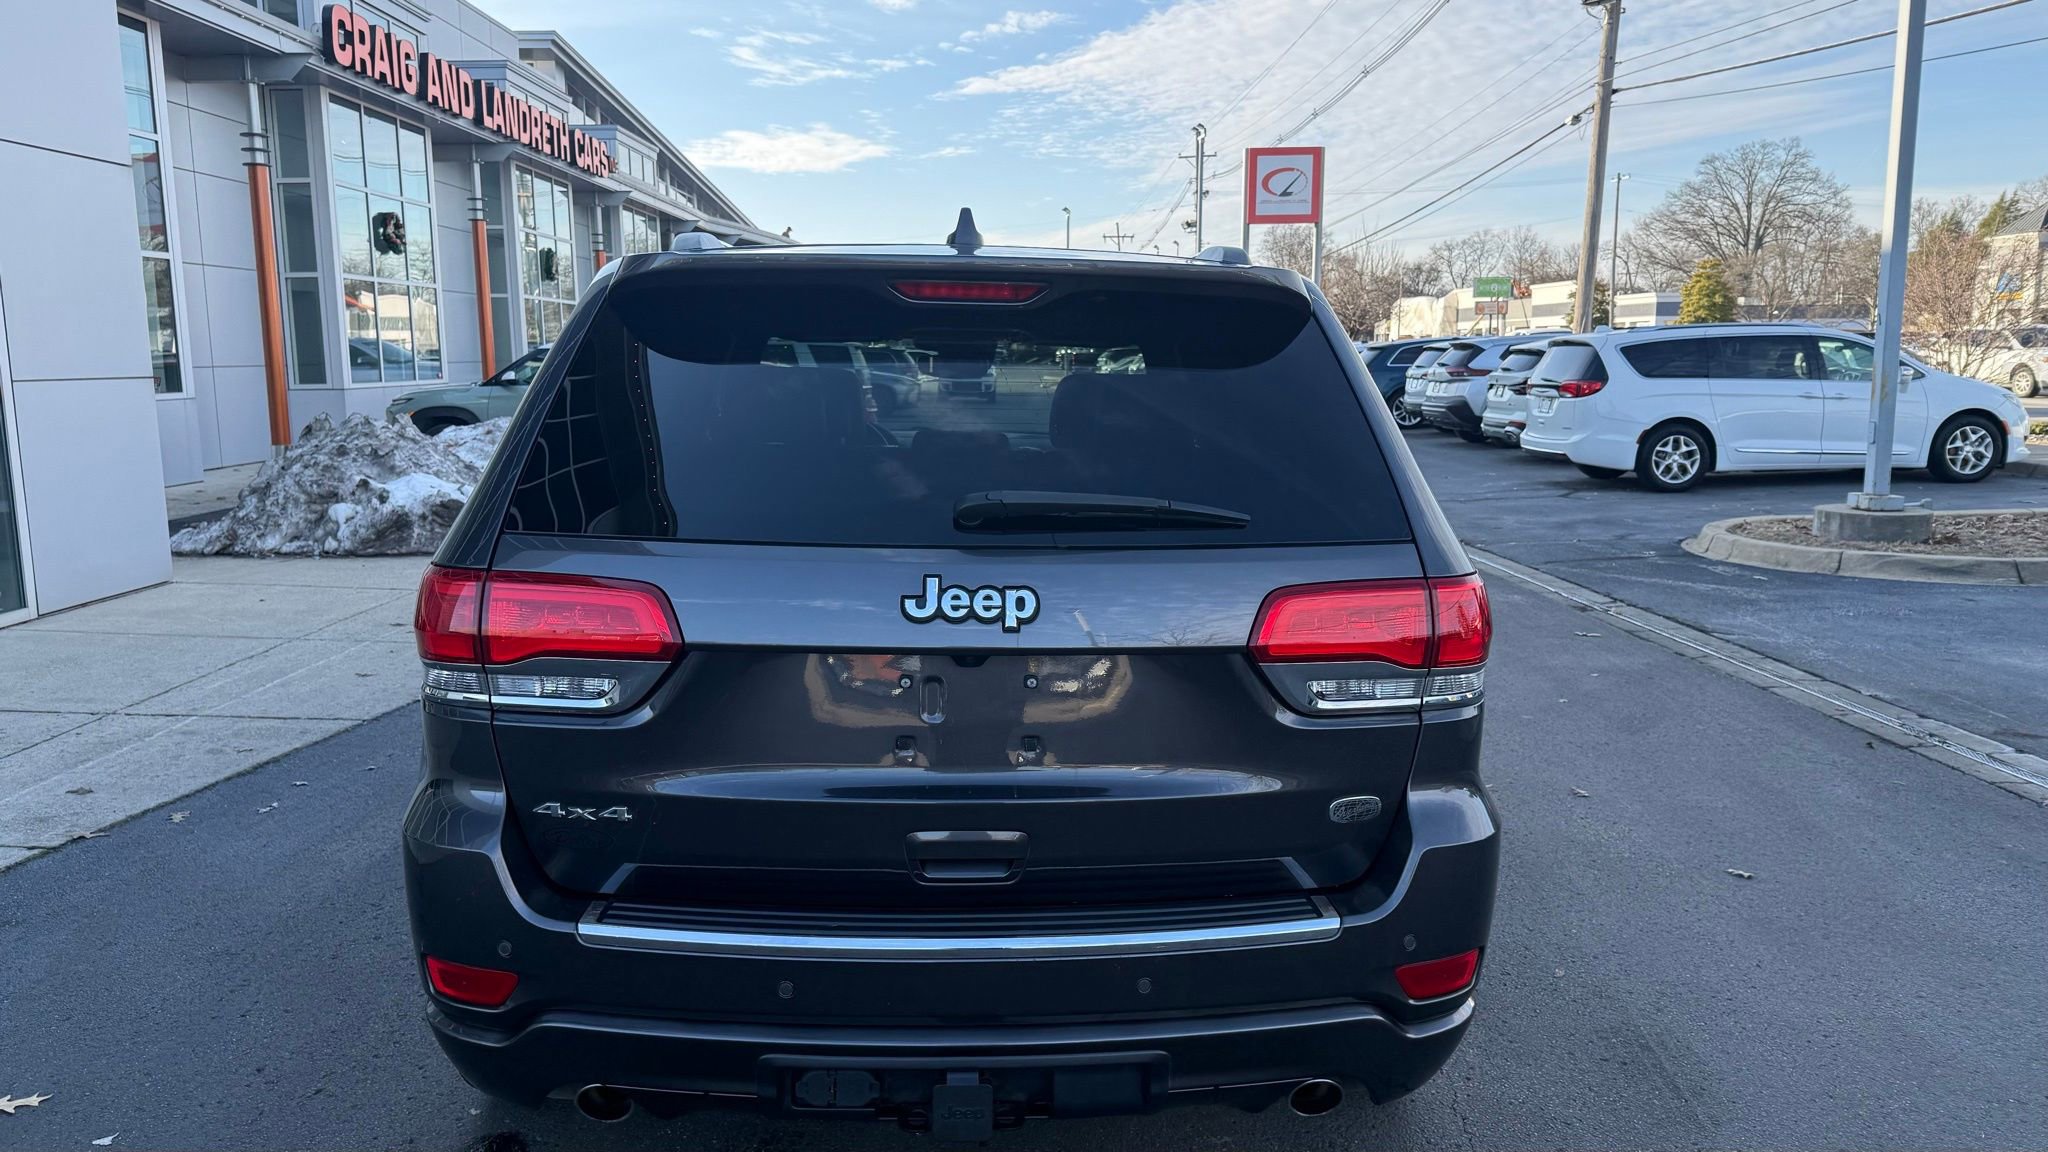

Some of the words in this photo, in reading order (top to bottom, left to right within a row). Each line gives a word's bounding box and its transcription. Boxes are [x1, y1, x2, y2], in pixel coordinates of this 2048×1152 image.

[330, 3, 418, 96] CRAIG
[425, 53, 476, 120] AND
[481, 80, 571, 163] LANDRETH
[573, 128, 609, 178] CARS
[902, 575, 1039, 631] Jeep
[532, 802, 633, 821] 4x4
